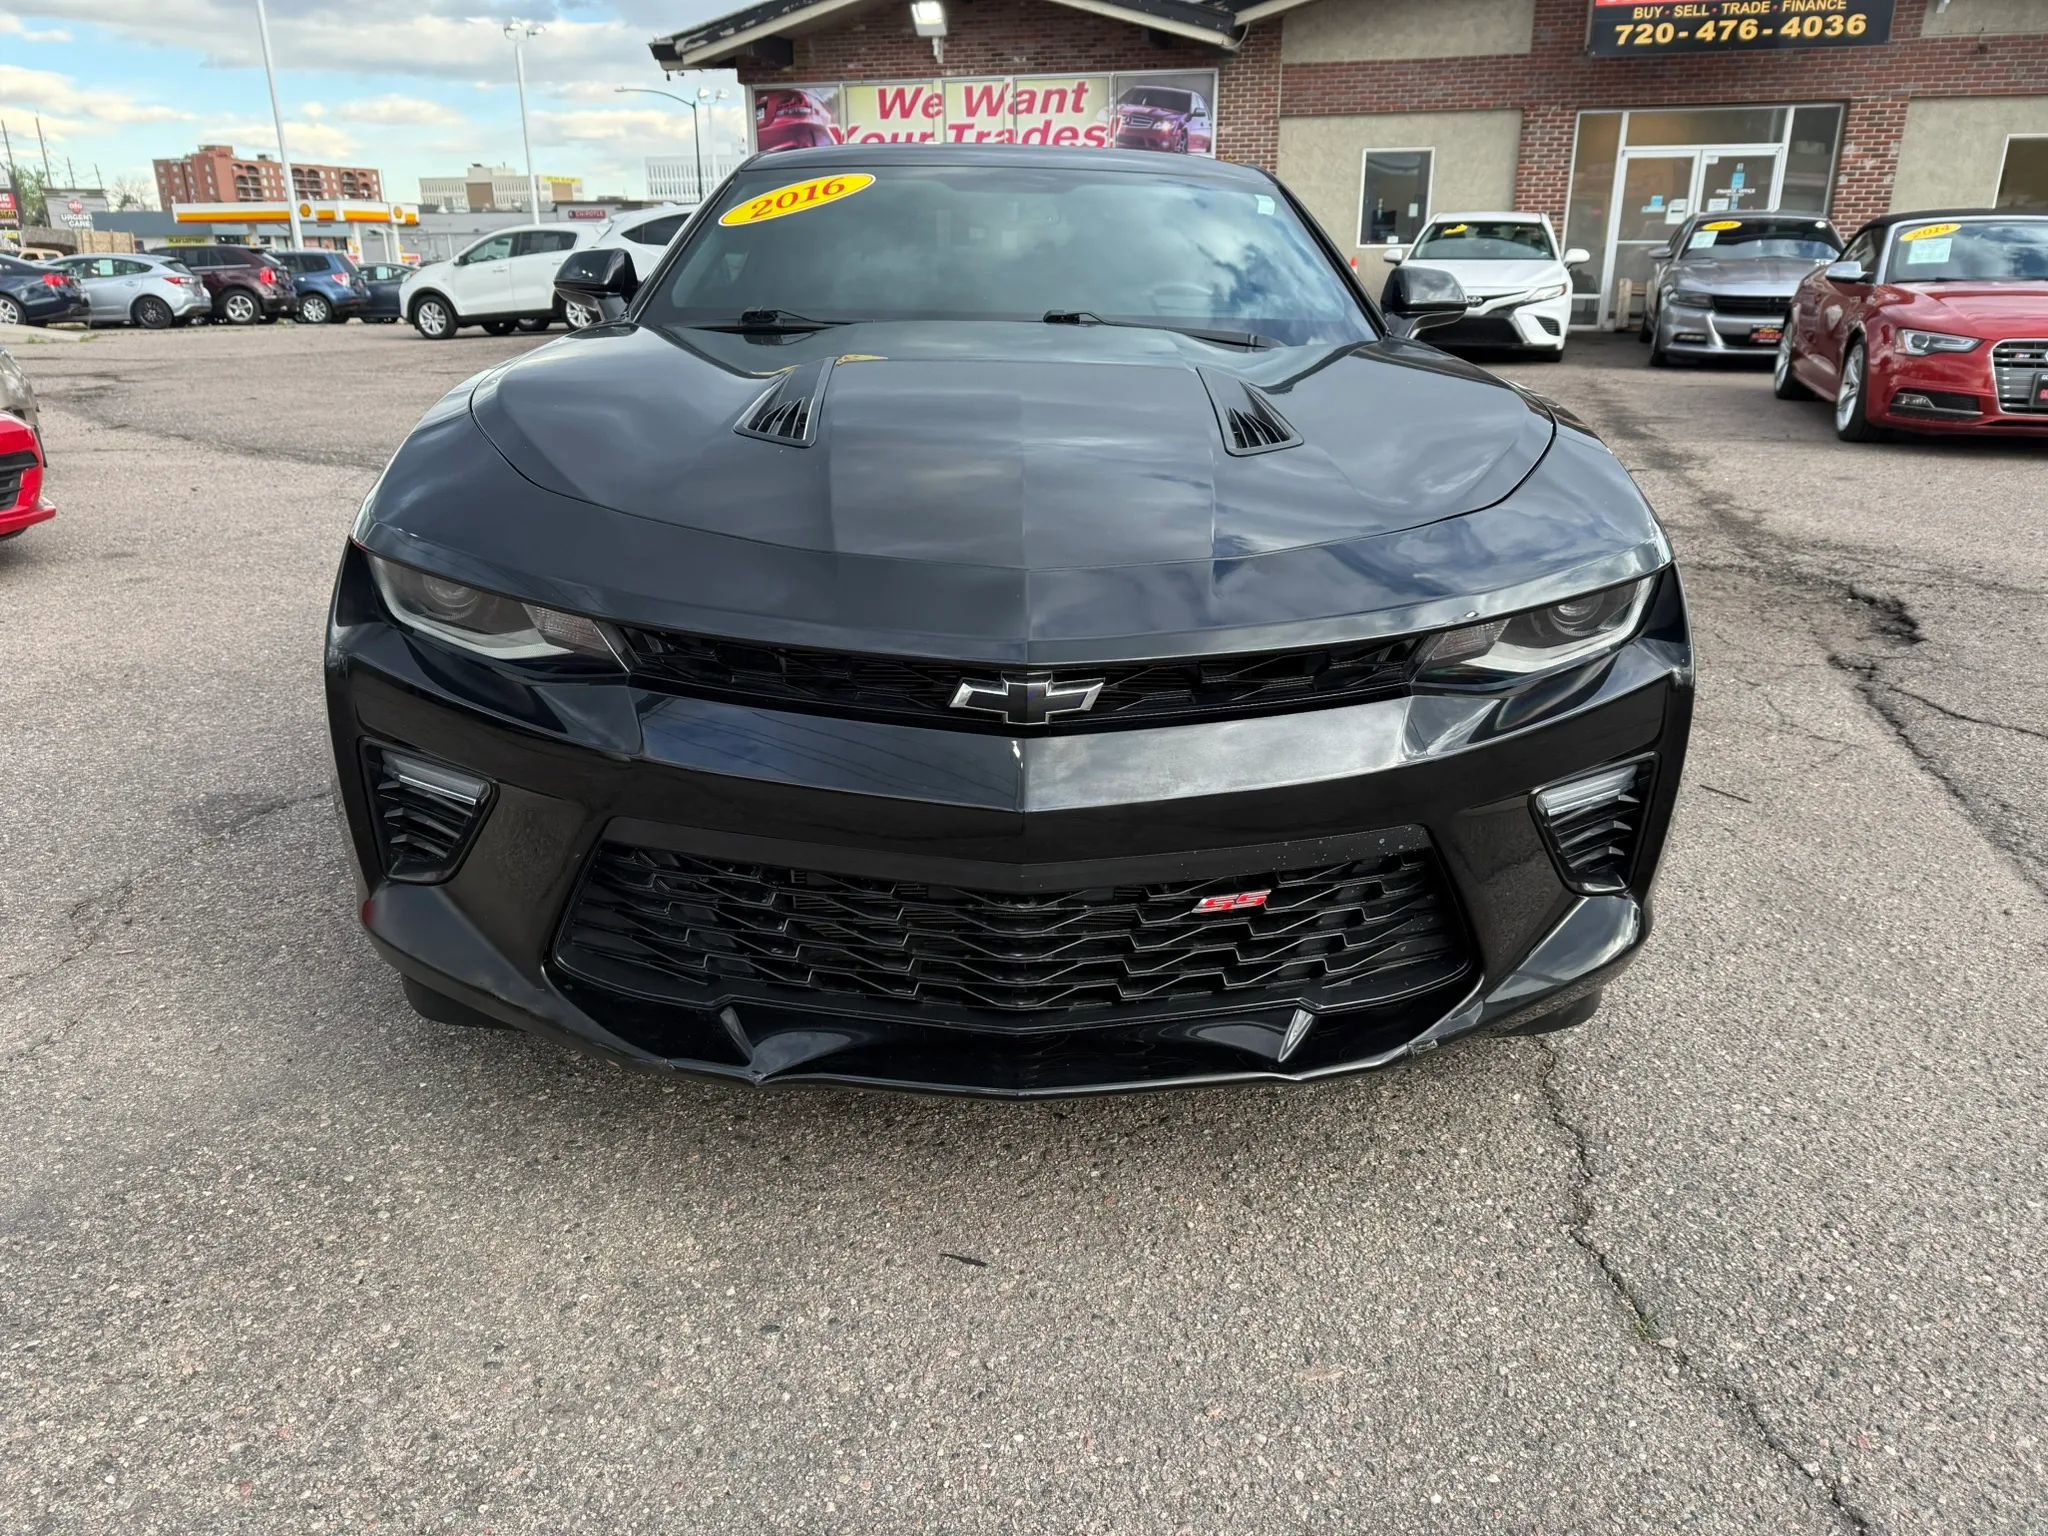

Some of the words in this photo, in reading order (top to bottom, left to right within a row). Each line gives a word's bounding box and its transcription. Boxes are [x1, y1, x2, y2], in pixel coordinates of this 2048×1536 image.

[1633, 5, 1664, 19] BUY
[1673, 4, 1710, 17] SELL
[1722, 2, 1771, 15] TRADE
[1782, 0, 1847, 12] FINANCE
[878, 87, 943, 119] We
[964, 82, 1088, 117] Want
[750, 176, 845, 219] 2016
[1195, 889, 1271, 913] SS
